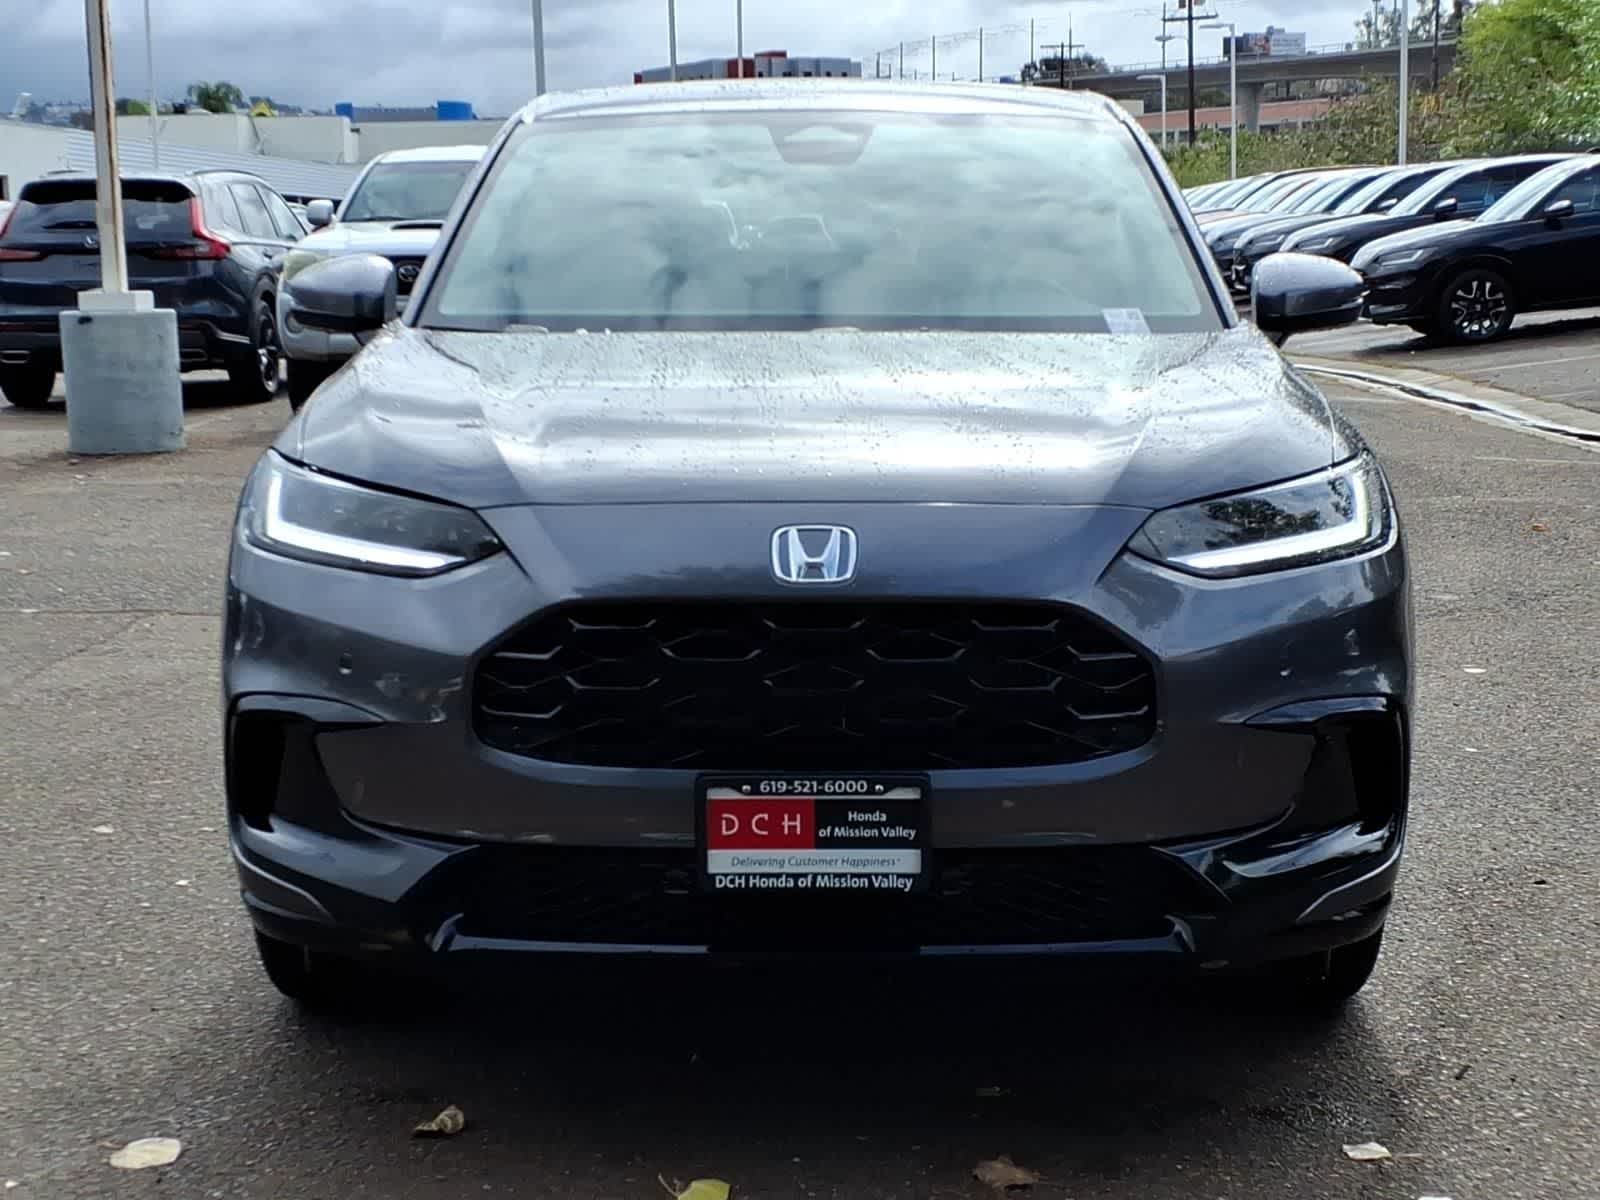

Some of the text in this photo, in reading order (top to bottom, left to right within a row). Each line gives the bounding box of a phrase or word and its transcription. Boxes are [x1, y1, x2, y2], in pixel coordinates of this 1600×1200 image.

[759, 780, 868, 793] 619-521-6000
[848, 811, 887, 822] Honda
[721, 813, 801, 835] DCH
[818, 826, 917, 840] of Mission Valley
[731, 856, 785, 868] Delivering
[788, 855, 839, 867] Customer
[715, 875, 913, 892] DCH Honda of Mission Valley
